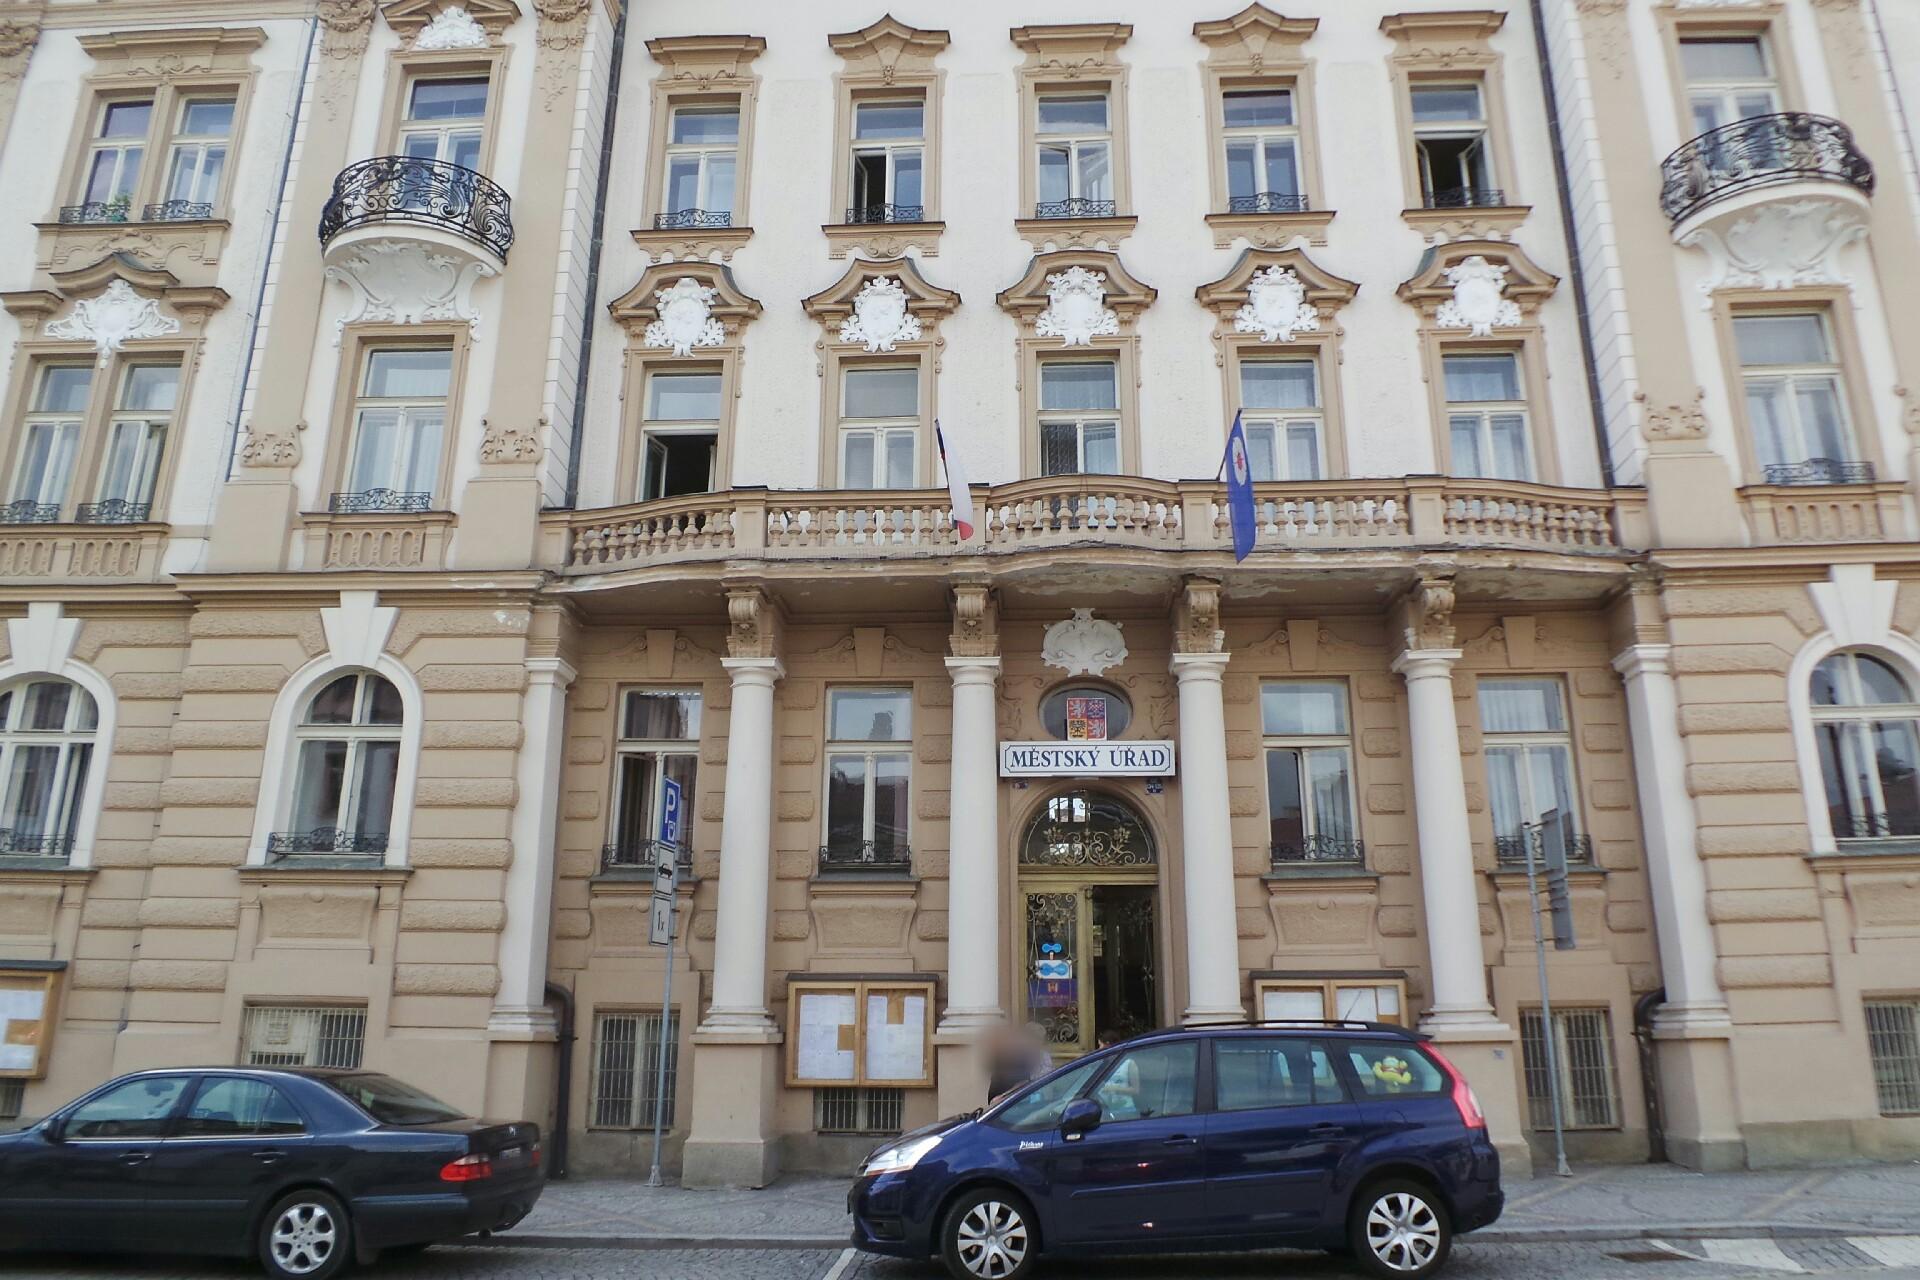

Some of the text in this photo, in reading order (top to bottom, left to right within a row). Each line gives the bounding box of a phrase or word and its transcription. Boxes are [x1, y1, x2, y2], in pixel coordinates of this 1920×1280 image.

[1010, 746, 1165, 767] MĚSTSKÝ ÚŘAD
[665, 787, 677, 824] P
